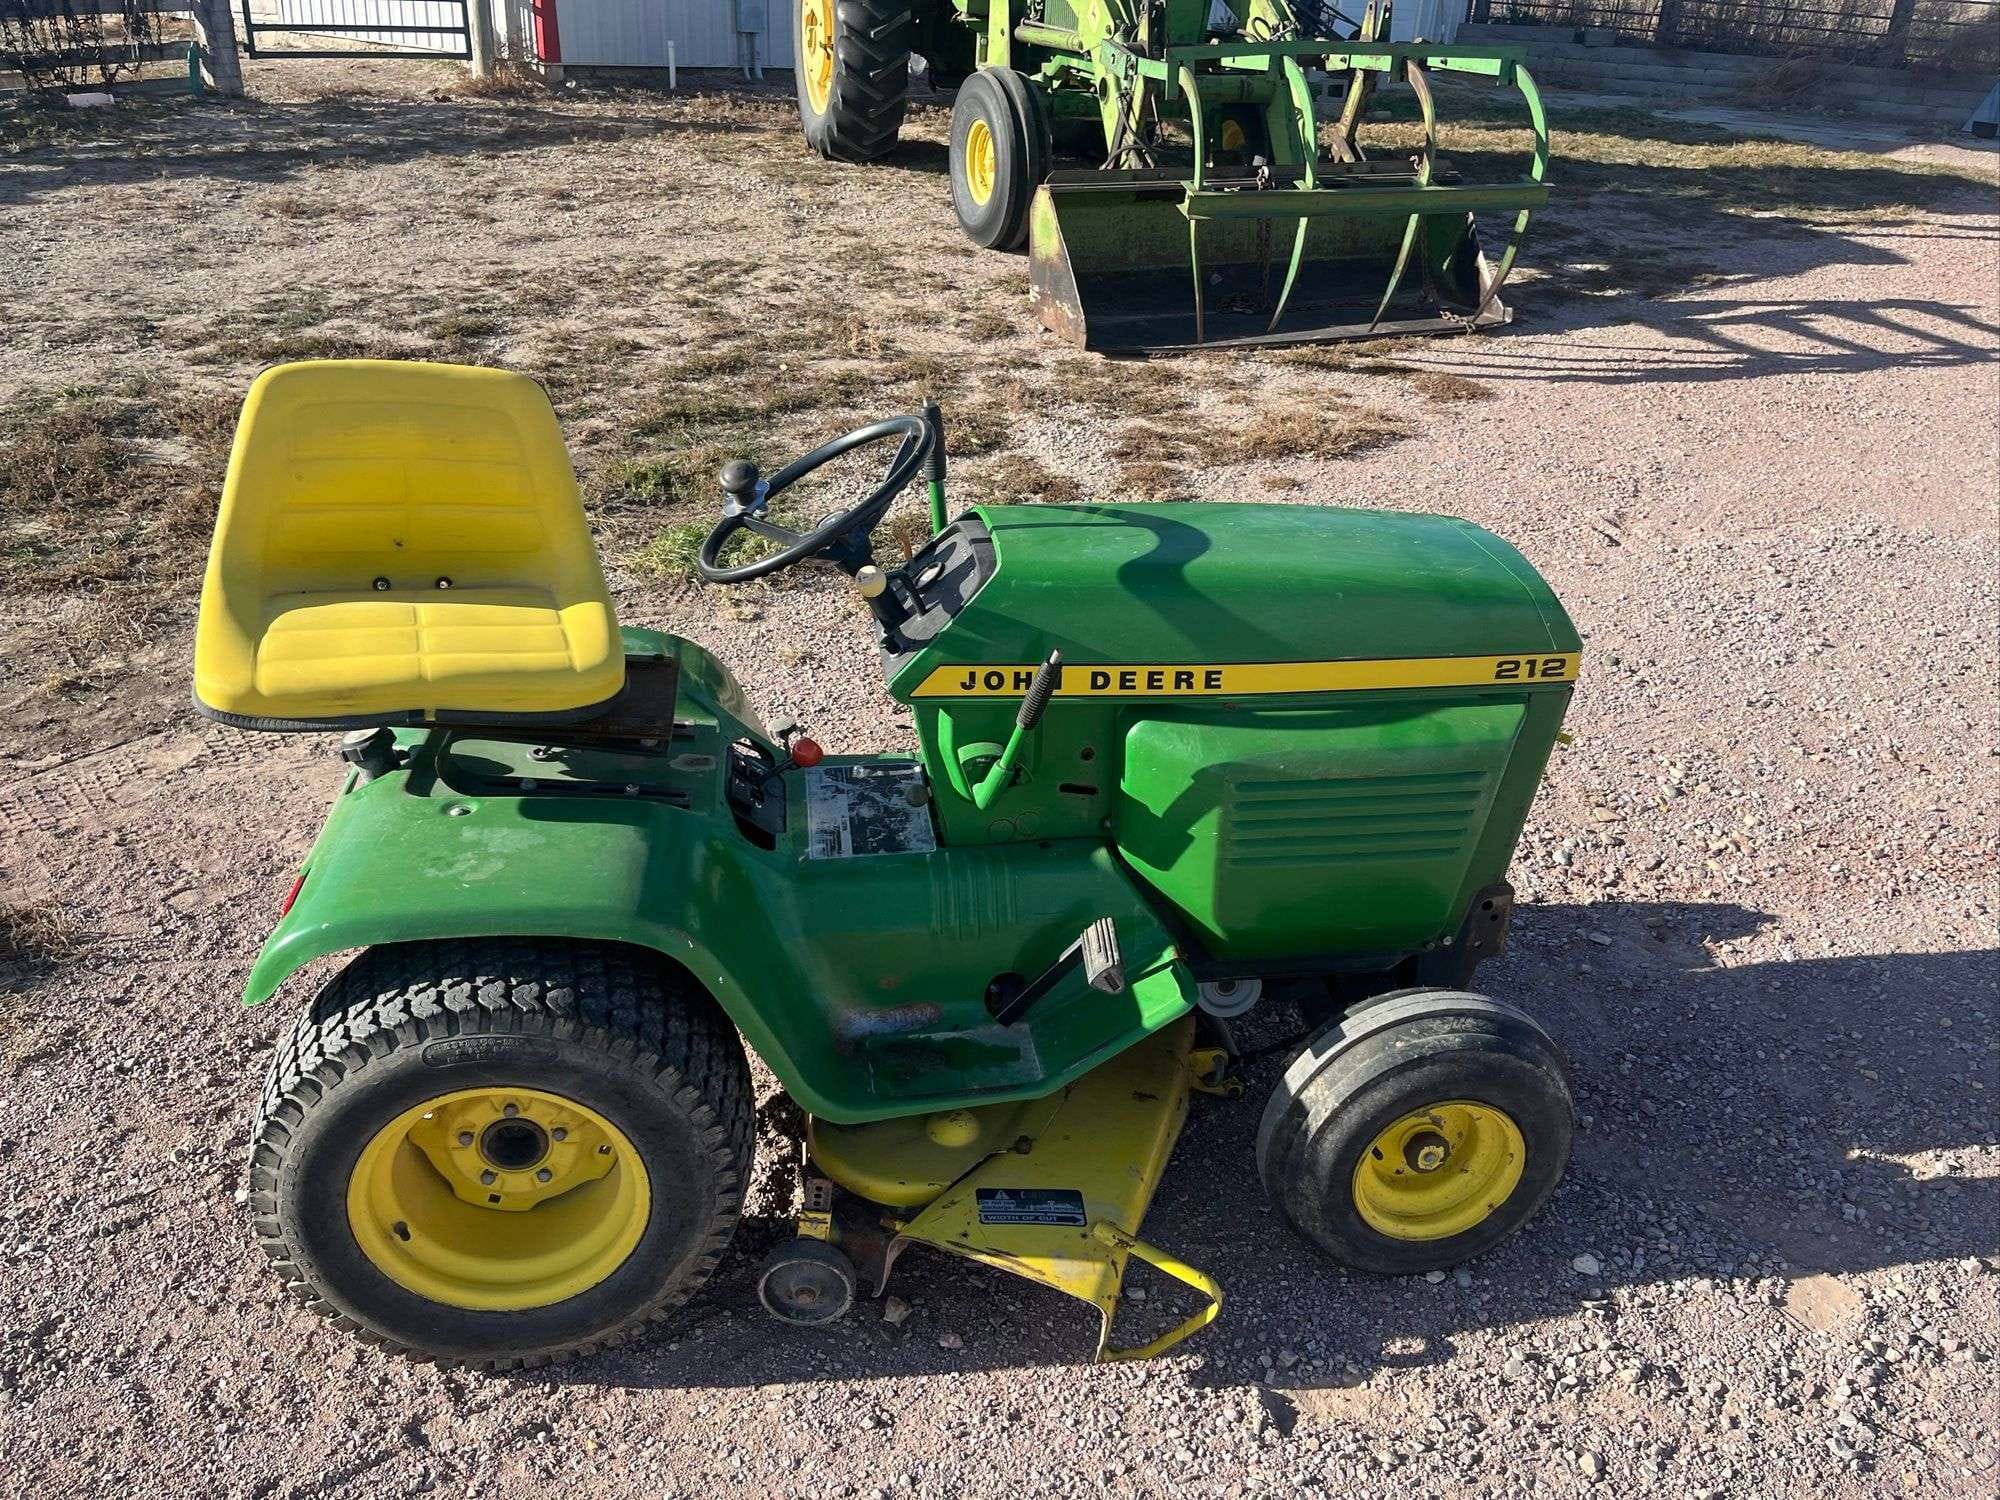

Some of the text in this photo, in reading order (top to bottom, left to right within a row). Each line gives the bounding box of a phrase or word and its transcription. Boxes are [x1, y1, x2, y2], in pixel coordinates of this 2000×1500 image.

[1494, 657, 1567, 680] 212
[960, 670, 1223, 691] JOH DEERE
[987, 1214, 1058, 1223] WIDTH OF CUT
